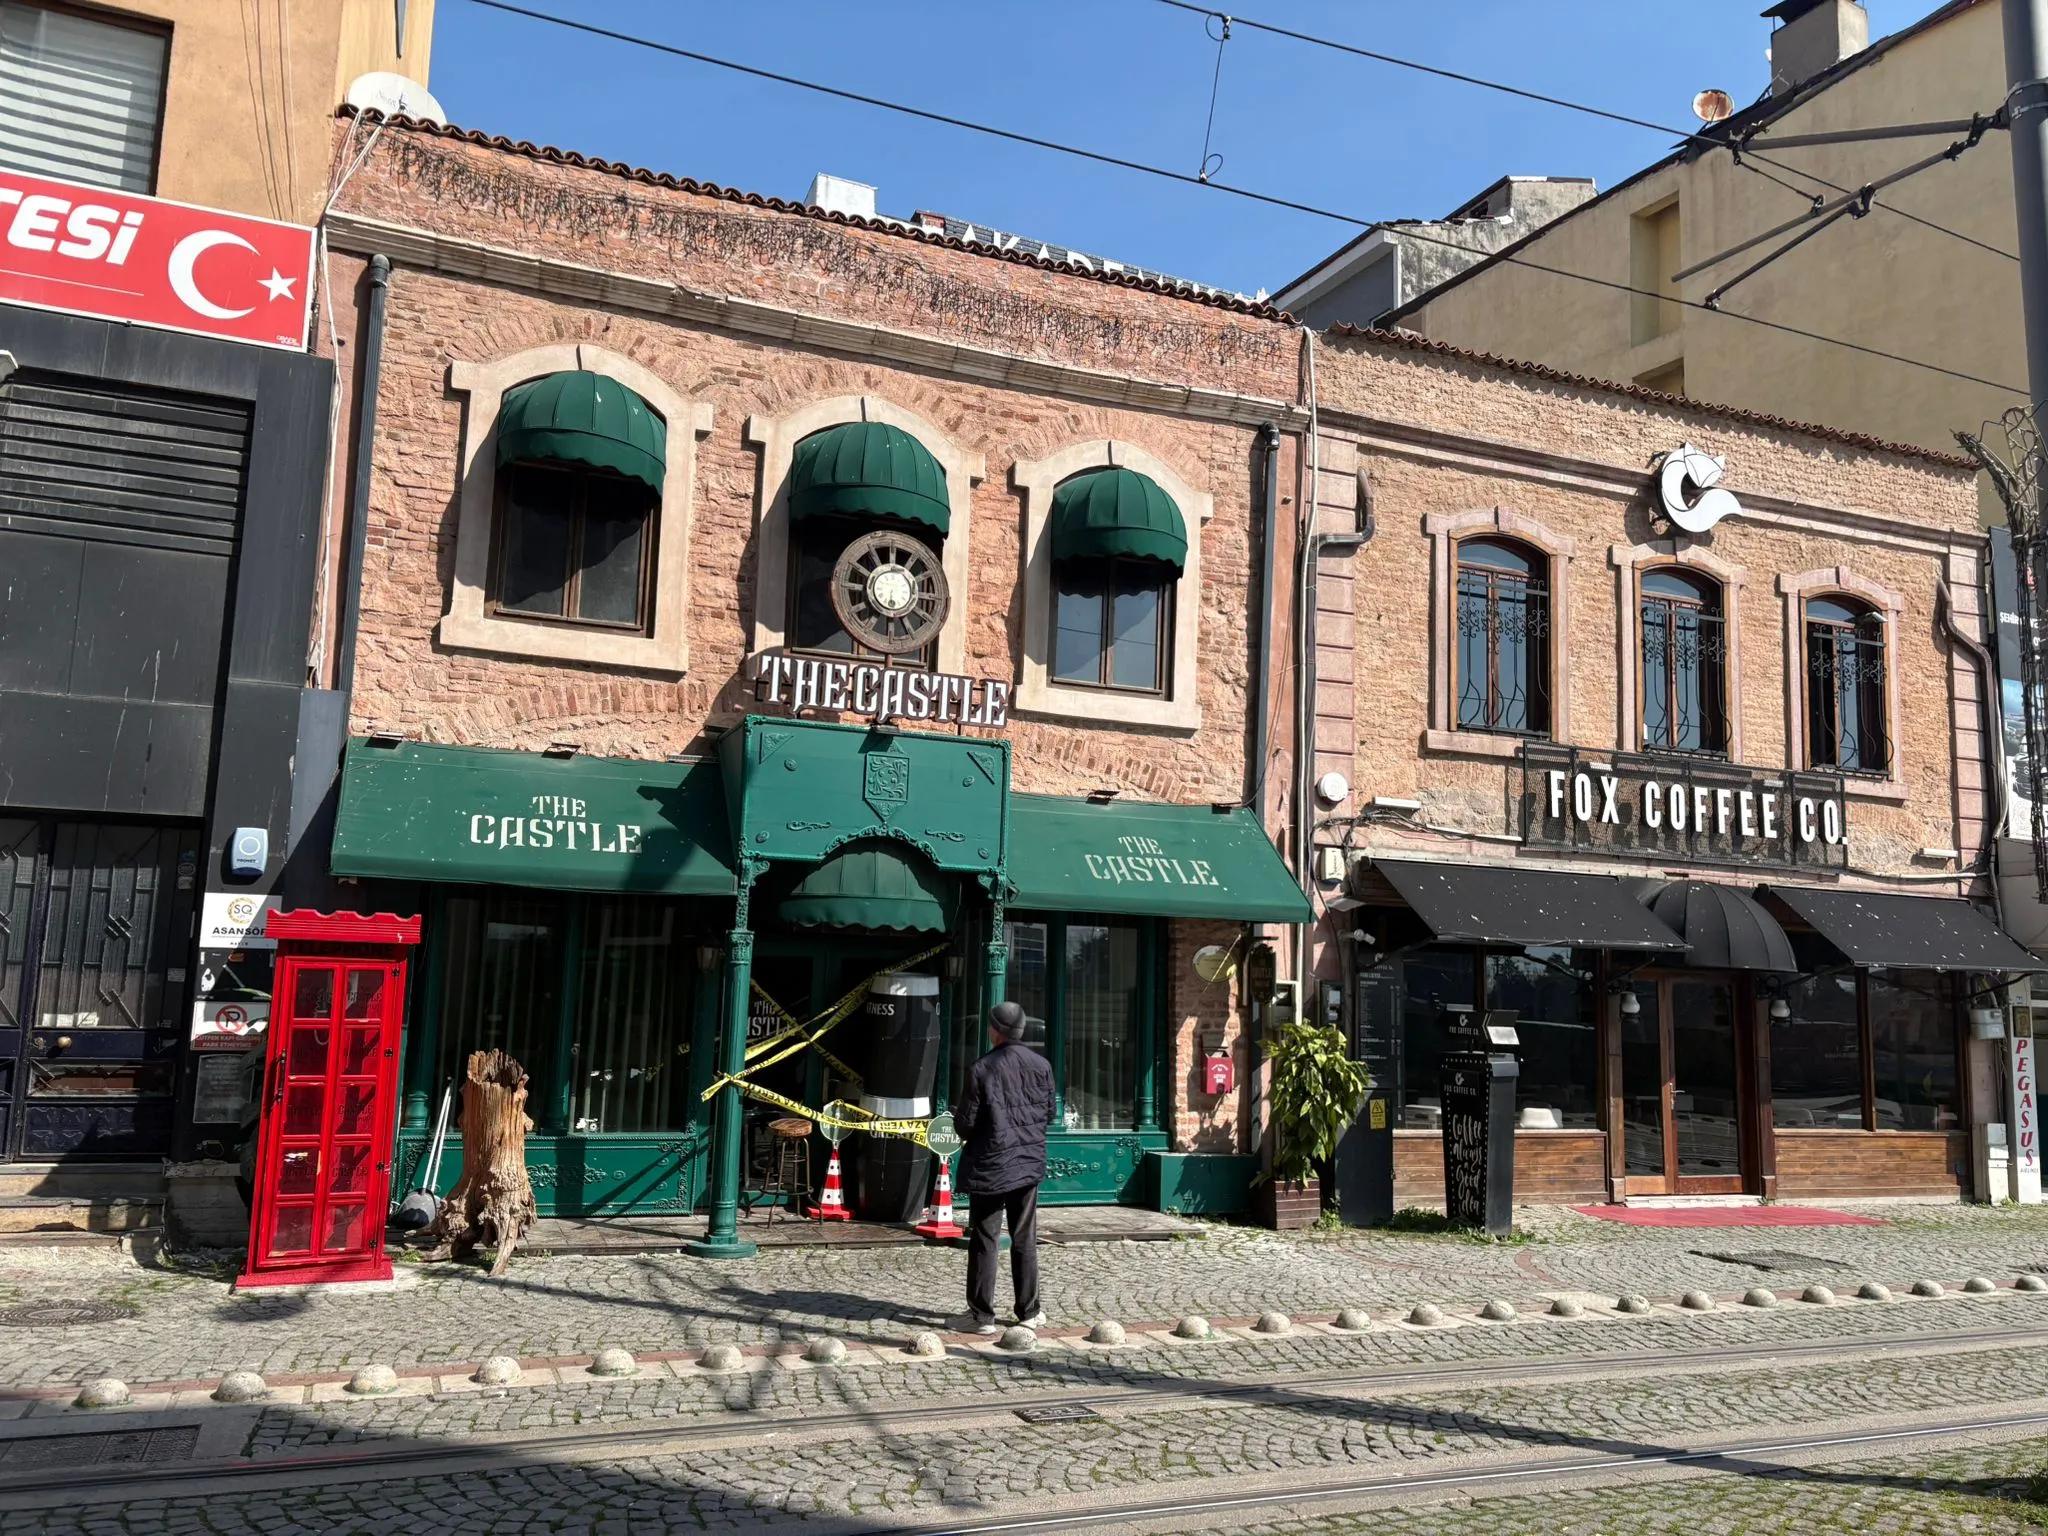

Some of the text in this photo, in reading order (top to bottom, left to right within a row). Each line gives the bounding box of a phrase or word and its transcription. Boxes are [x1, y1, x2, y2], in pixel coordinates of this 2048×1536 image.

[761, 655, 1007, 726] THE CASTLE
[532, 795, 587, 818] THE
[1549, 770, 1848, 845] FOX COFFEE CO.
[470, 814, 643, 854] CASTLE
[1117, 836, 1164, 857] THE
[1084, 854, 1220, 886] CASTLE
[2015, 1039, 2035, 1167] PEGASUS
[930, 1132, 961, 1144] CASTLE
[1452, 1113, 1482, 1146] Coffee
